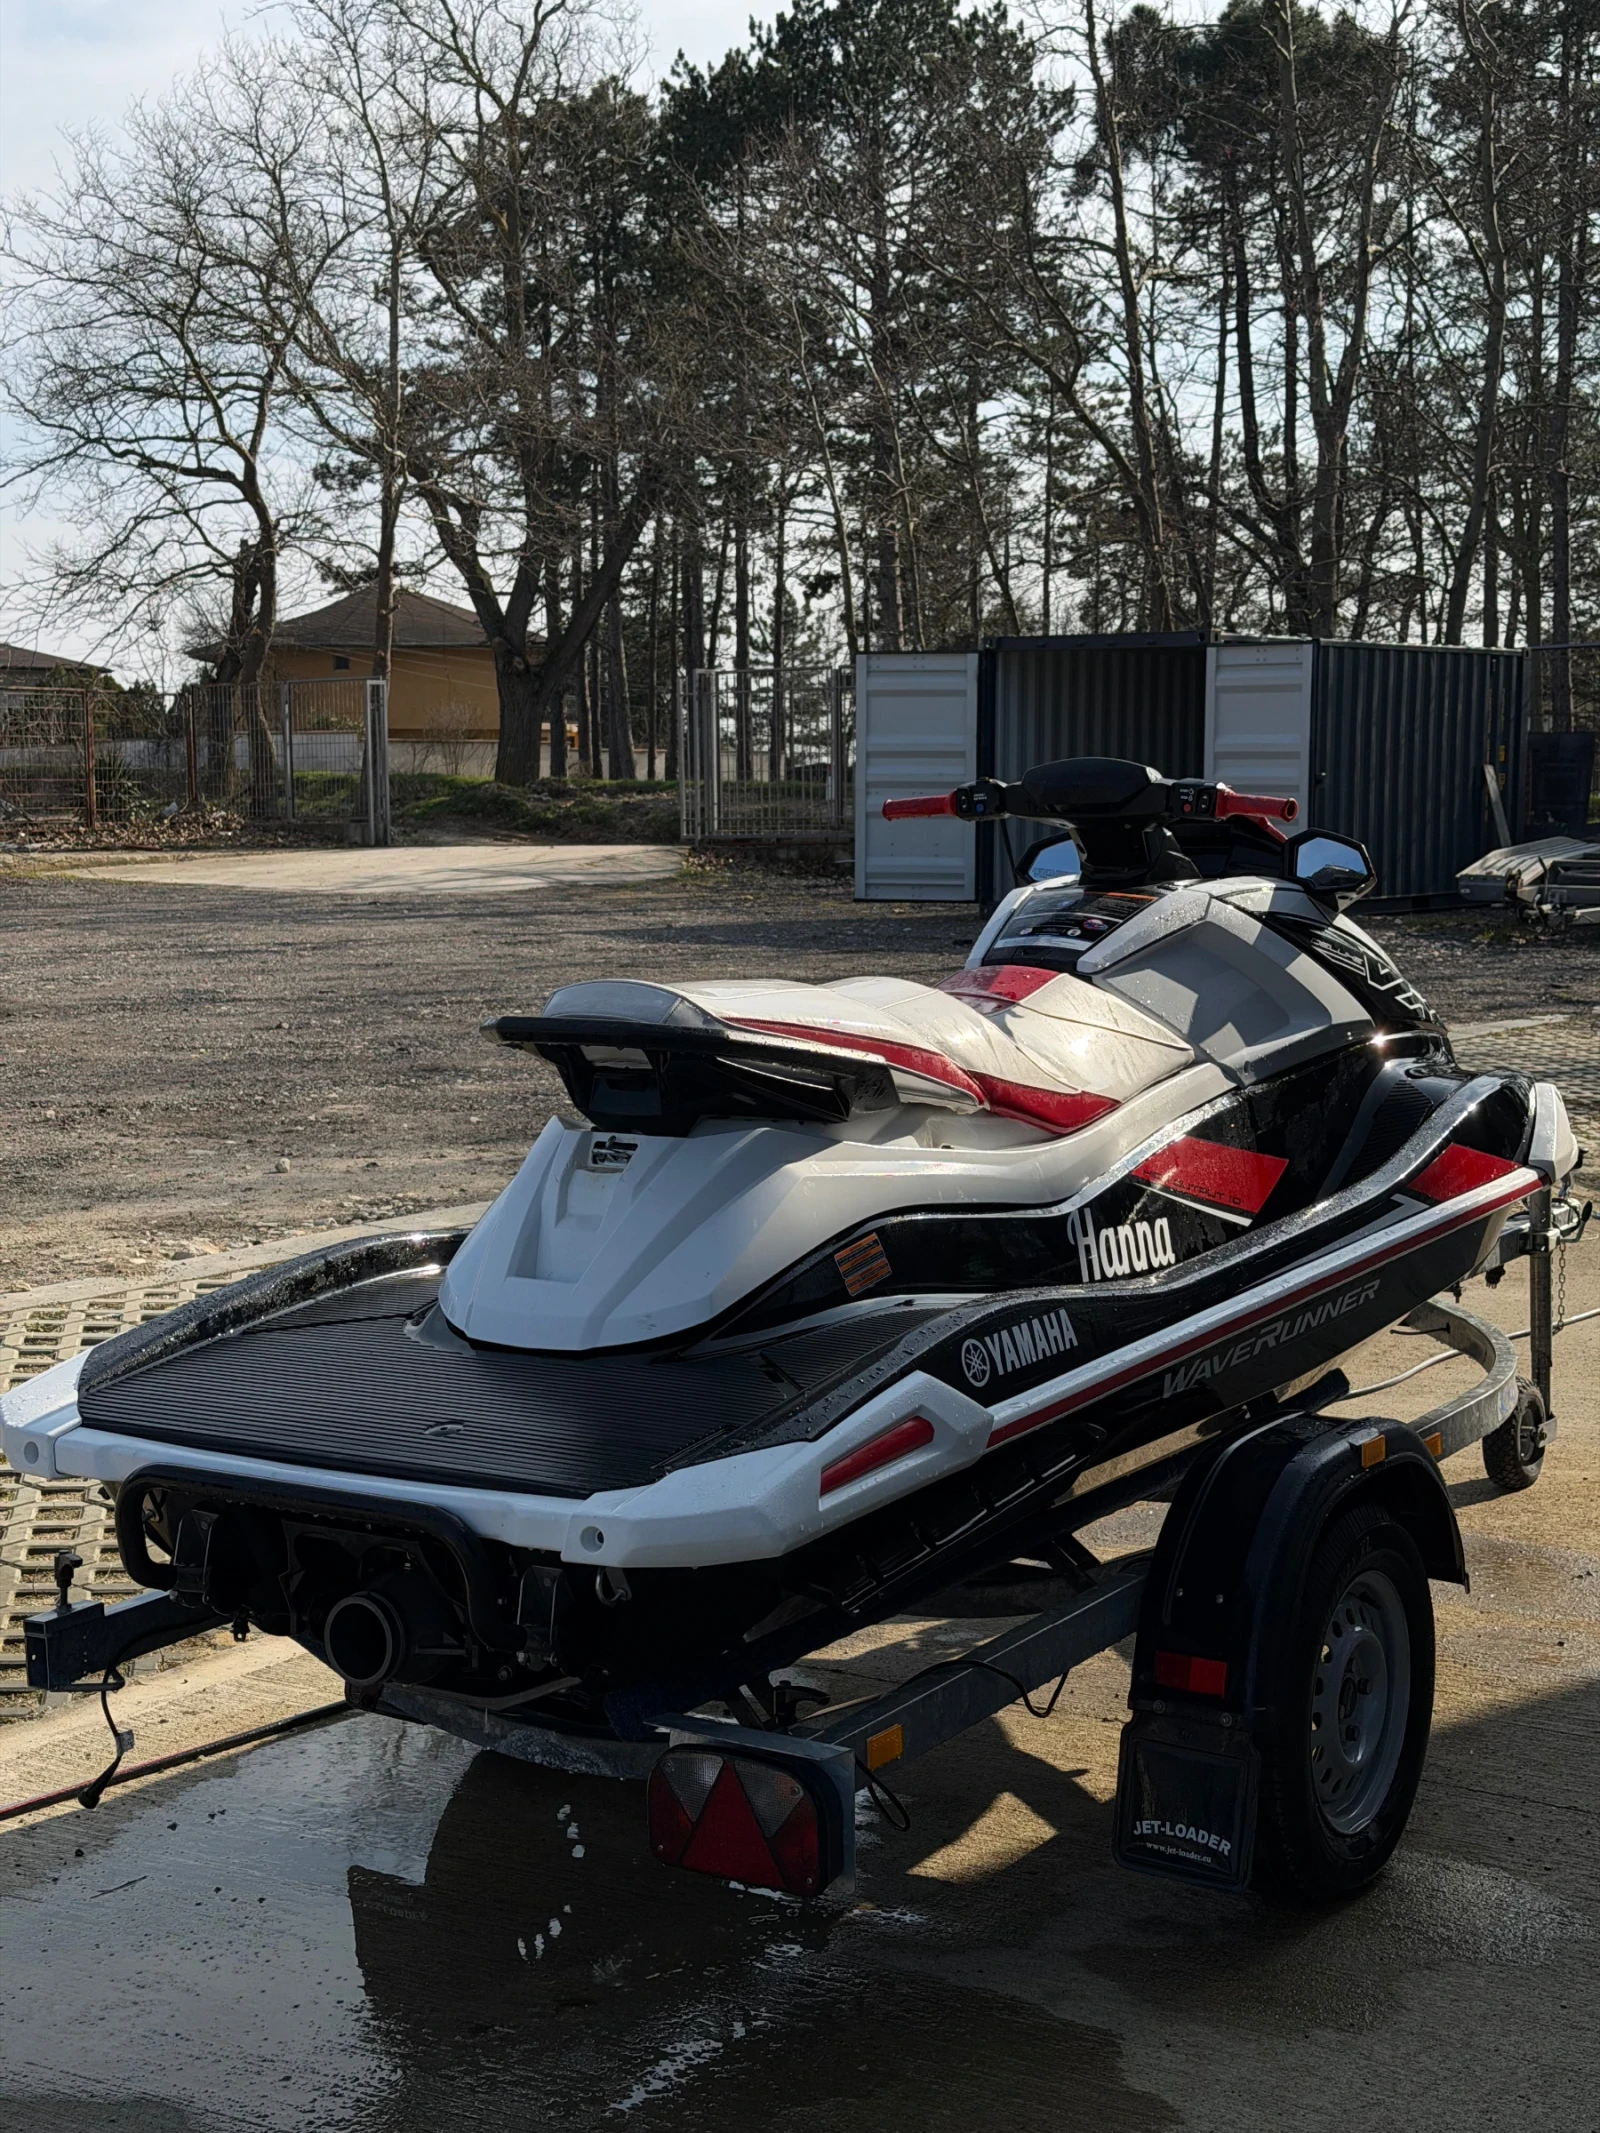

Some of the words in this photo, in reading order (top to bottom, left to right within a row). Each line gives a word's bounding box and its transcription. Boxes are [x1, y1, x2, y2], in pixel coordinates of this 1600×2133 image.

[1067, 1207, 1176, 1283] Hanna
[987, 1308, 1079, 1376] YAMAHA
[1162, 1280, 1381, 1399] WAVERUNNER
[1133, 1820, 1232, 1856] JET-LOADER
[1146, 1841, 1212, 1863] www.jet-loader.eu
